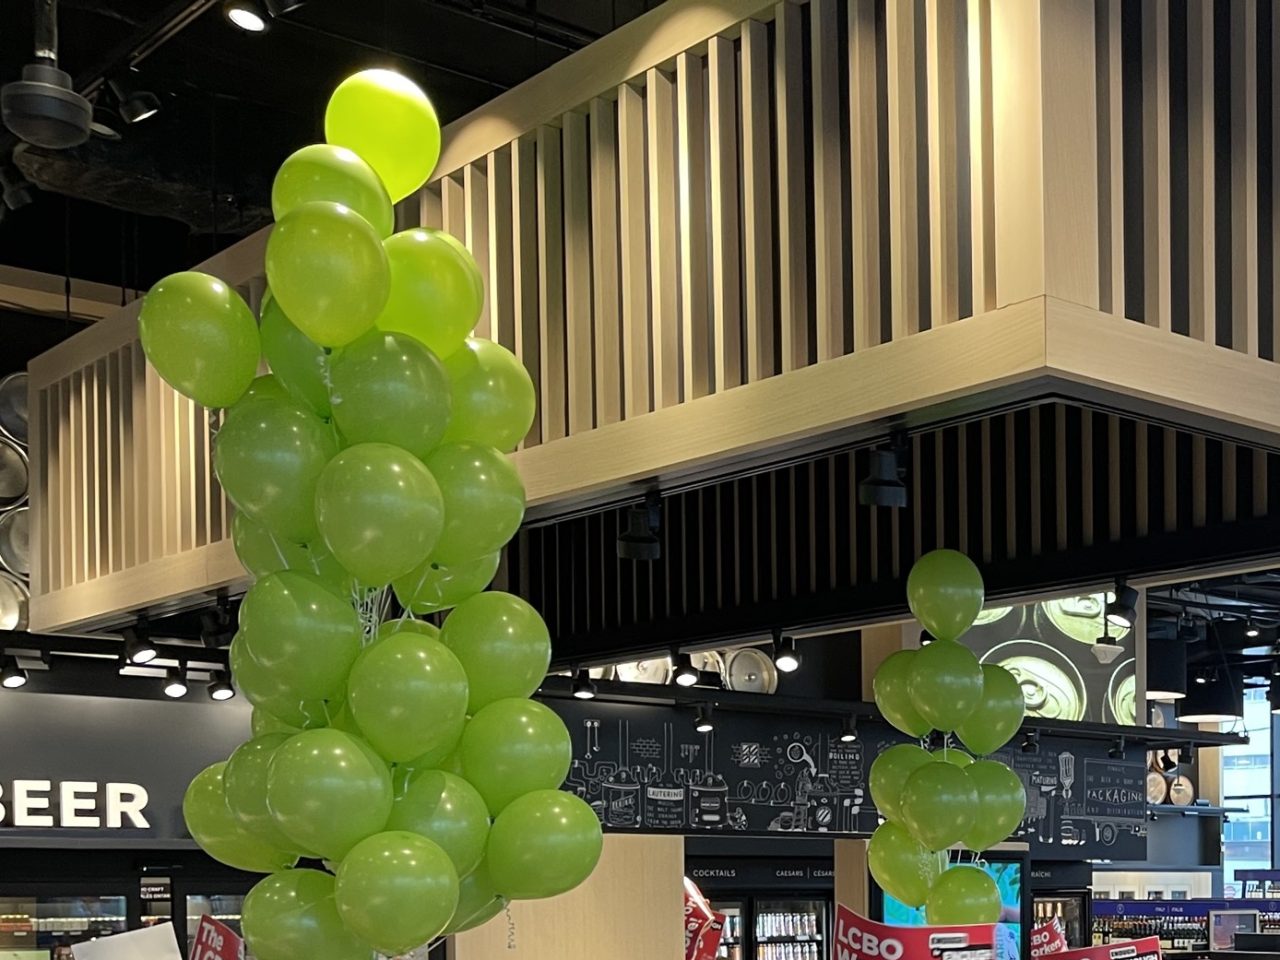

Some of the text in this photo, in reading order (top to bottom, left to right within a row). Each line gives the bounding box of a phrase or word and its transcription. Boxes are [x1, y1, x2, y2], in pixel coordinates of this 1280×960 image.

[0, 780, 151, 829] EER
[1087, 788, 1143, 802] PACKAGING
[693, 869, 736, 877] COCKTAILS
[202, 922, 224, 951] The
[837, 918, 904, 960] LCBO
